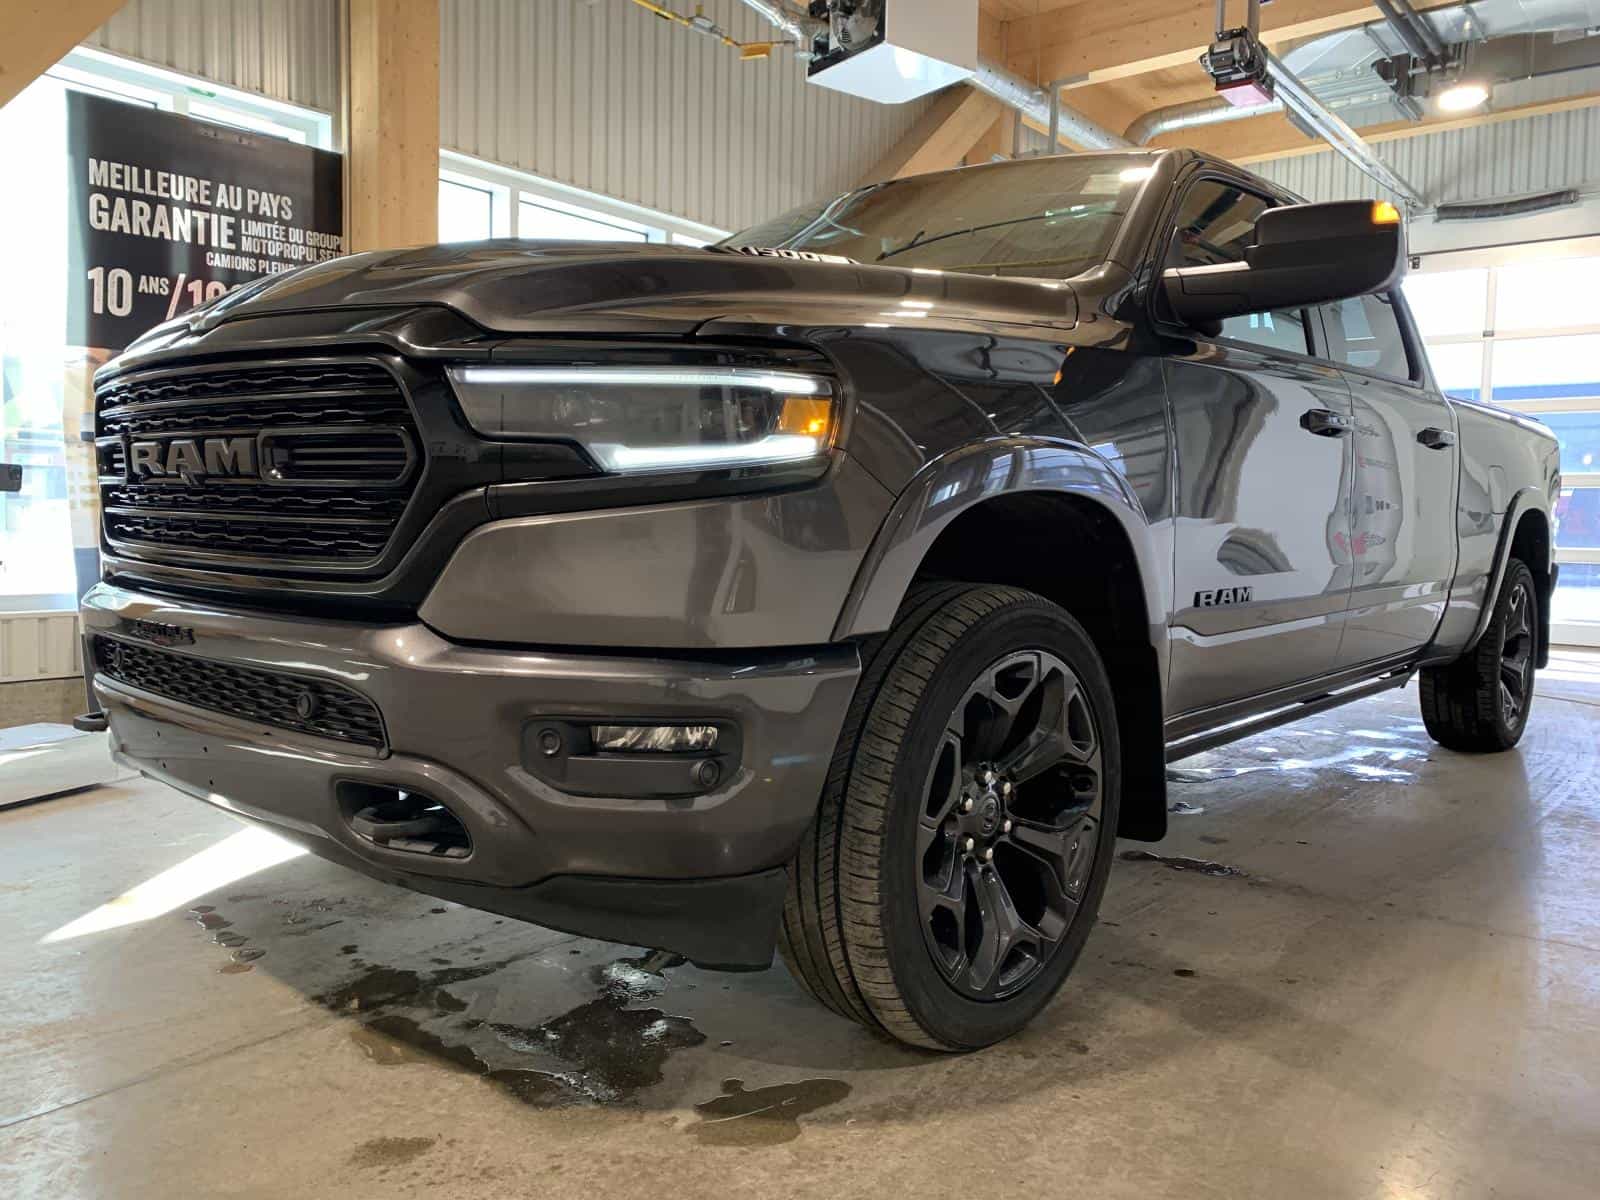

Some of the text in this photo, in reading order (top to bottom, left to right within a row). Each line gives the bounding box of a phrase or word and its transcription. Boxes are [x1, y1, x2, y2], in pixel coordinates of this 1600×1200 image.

[88, 158, 293, 220] MEILLEURE AU PAYS
[88, 193, 236, 250] GARANTIE
[241, 218, 286, 241] LIMITÉE
[289, 227, 303, 243] DU
[206, 252, 256, 273] CAMIONS
[88, 266, 132, 317] 10
[138, 275, 169, 295] ANS
[130, 438, 254, 475] RAM
[1193, 586, 1255, 607] RAM
